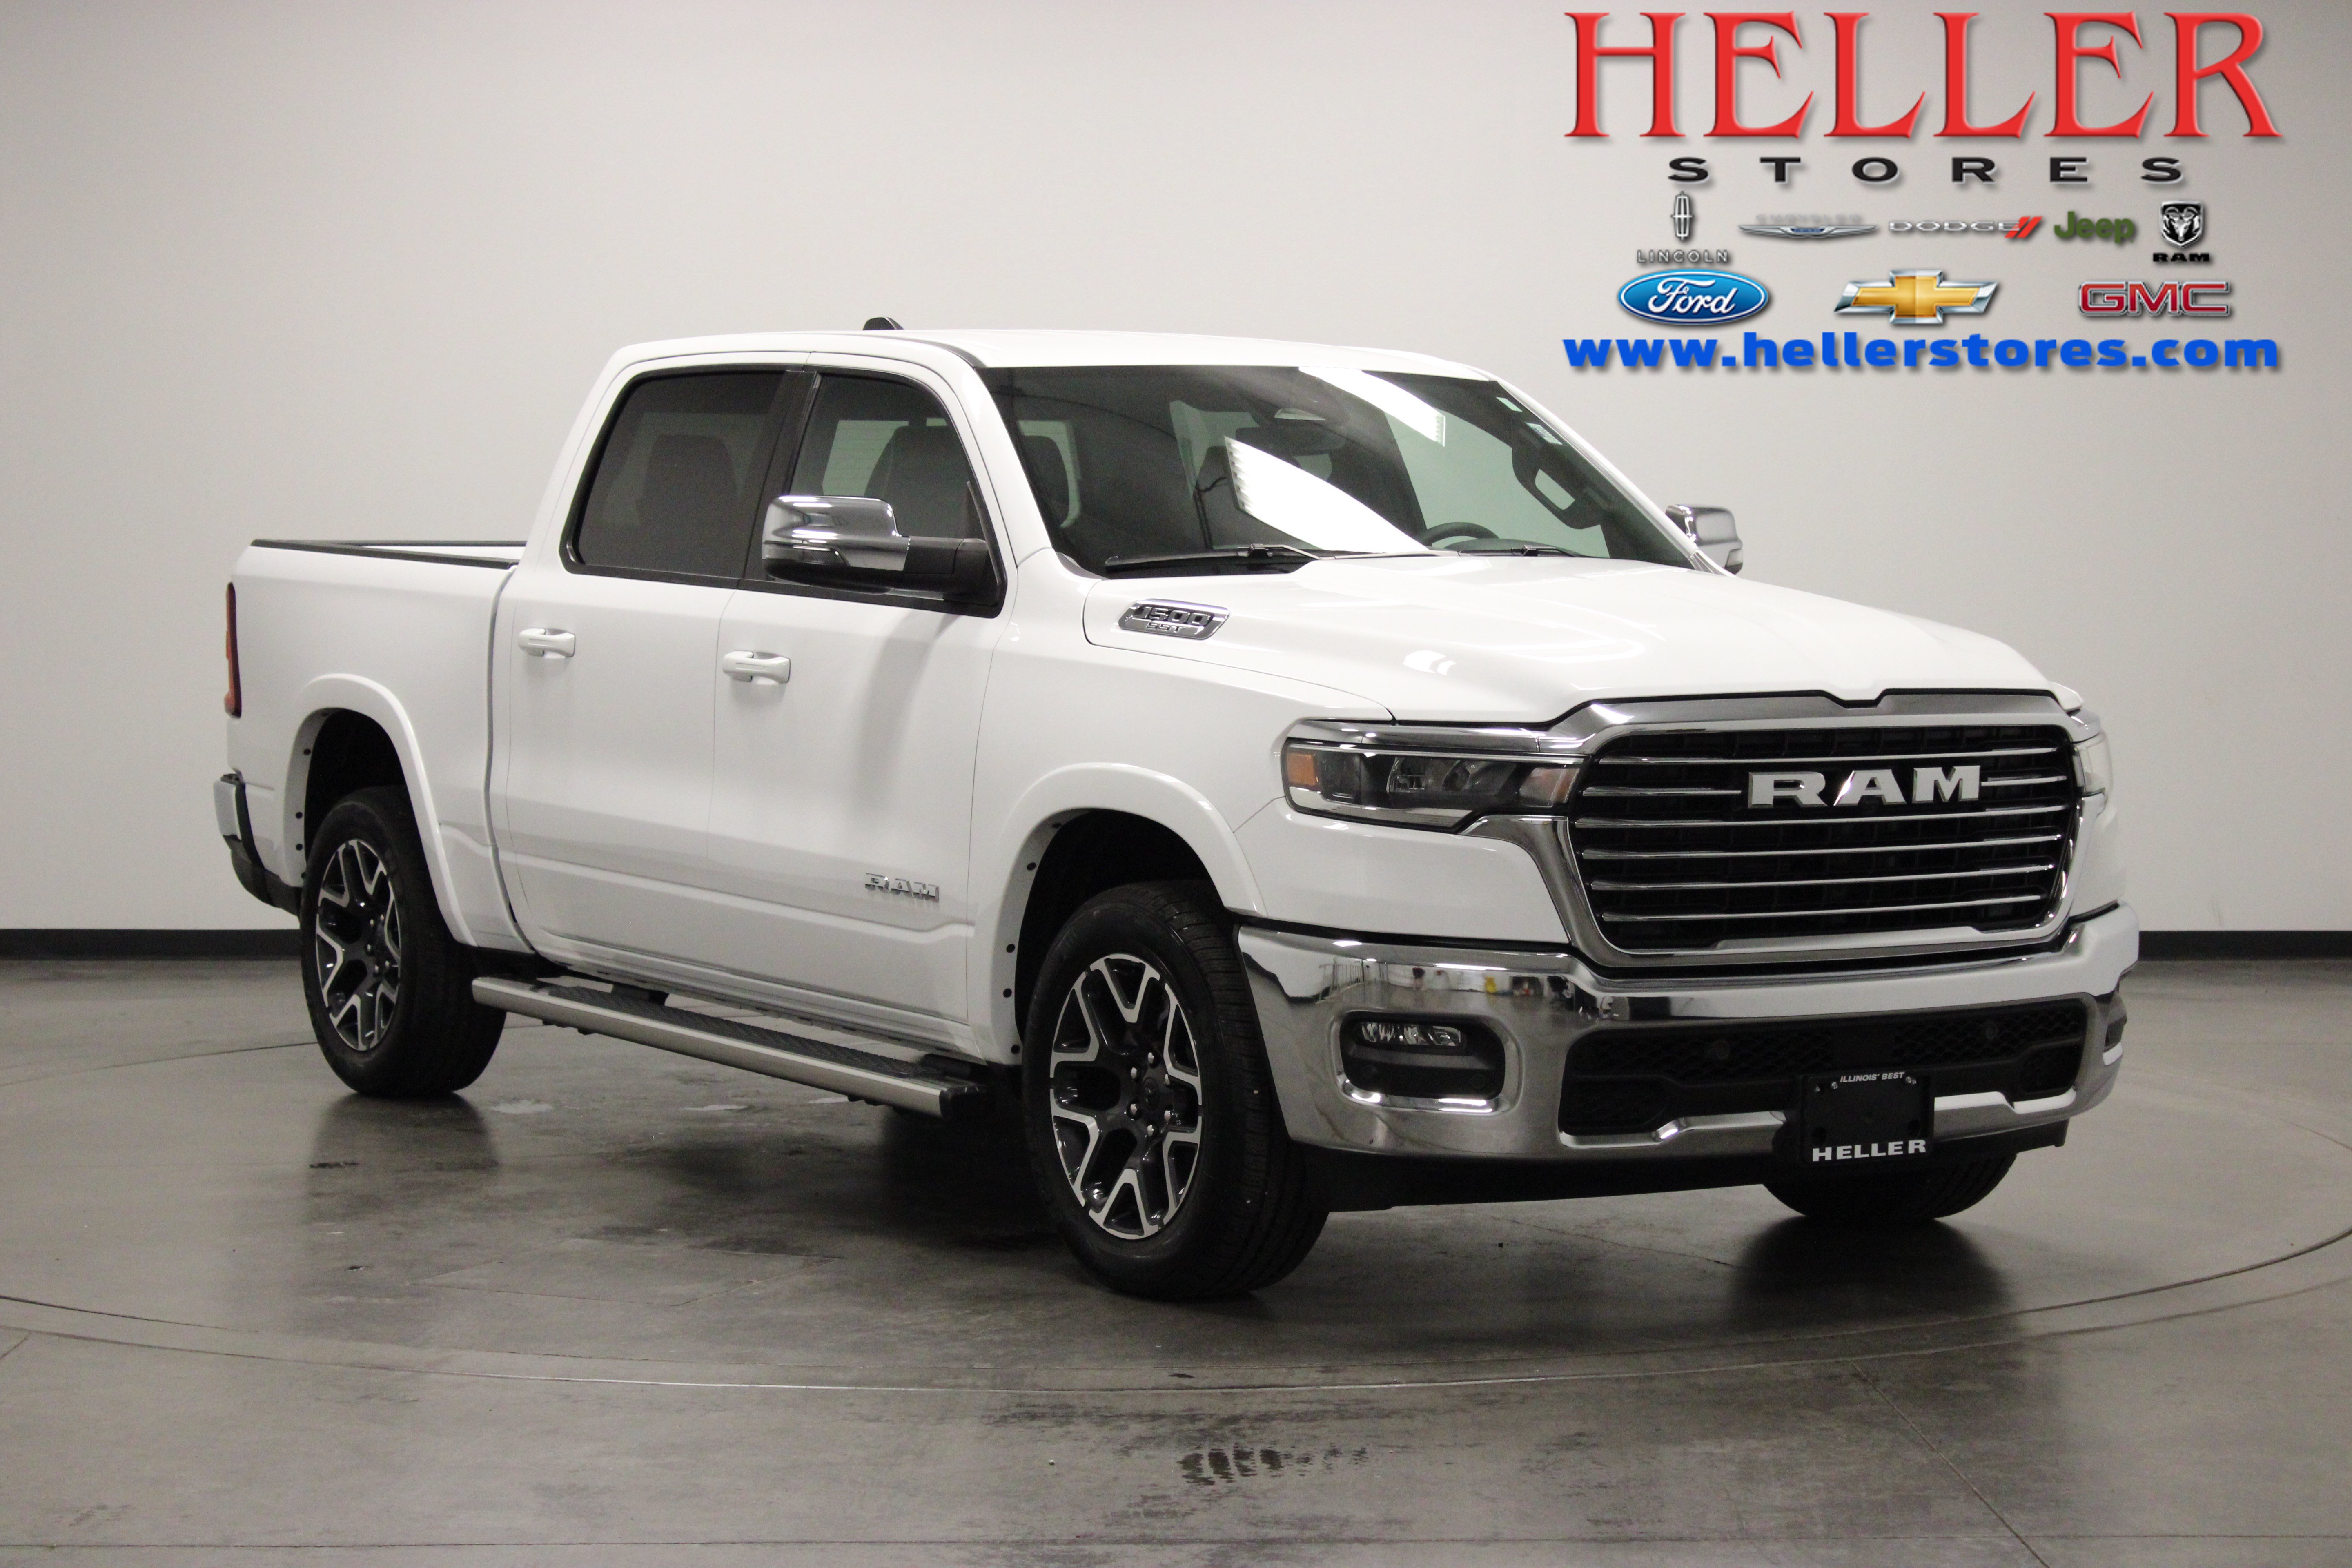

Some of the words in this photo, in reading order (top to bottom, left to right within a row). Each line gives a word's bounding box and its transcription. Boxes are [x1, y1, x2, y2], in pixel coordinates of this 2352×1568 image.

[1748, 765, 1980, 808] RAM
[864, 873, 939, 902] RAM
[1882, 1071, 1905, 1080] BEST
[1812, 1140, 1926, 1162] HELLER
